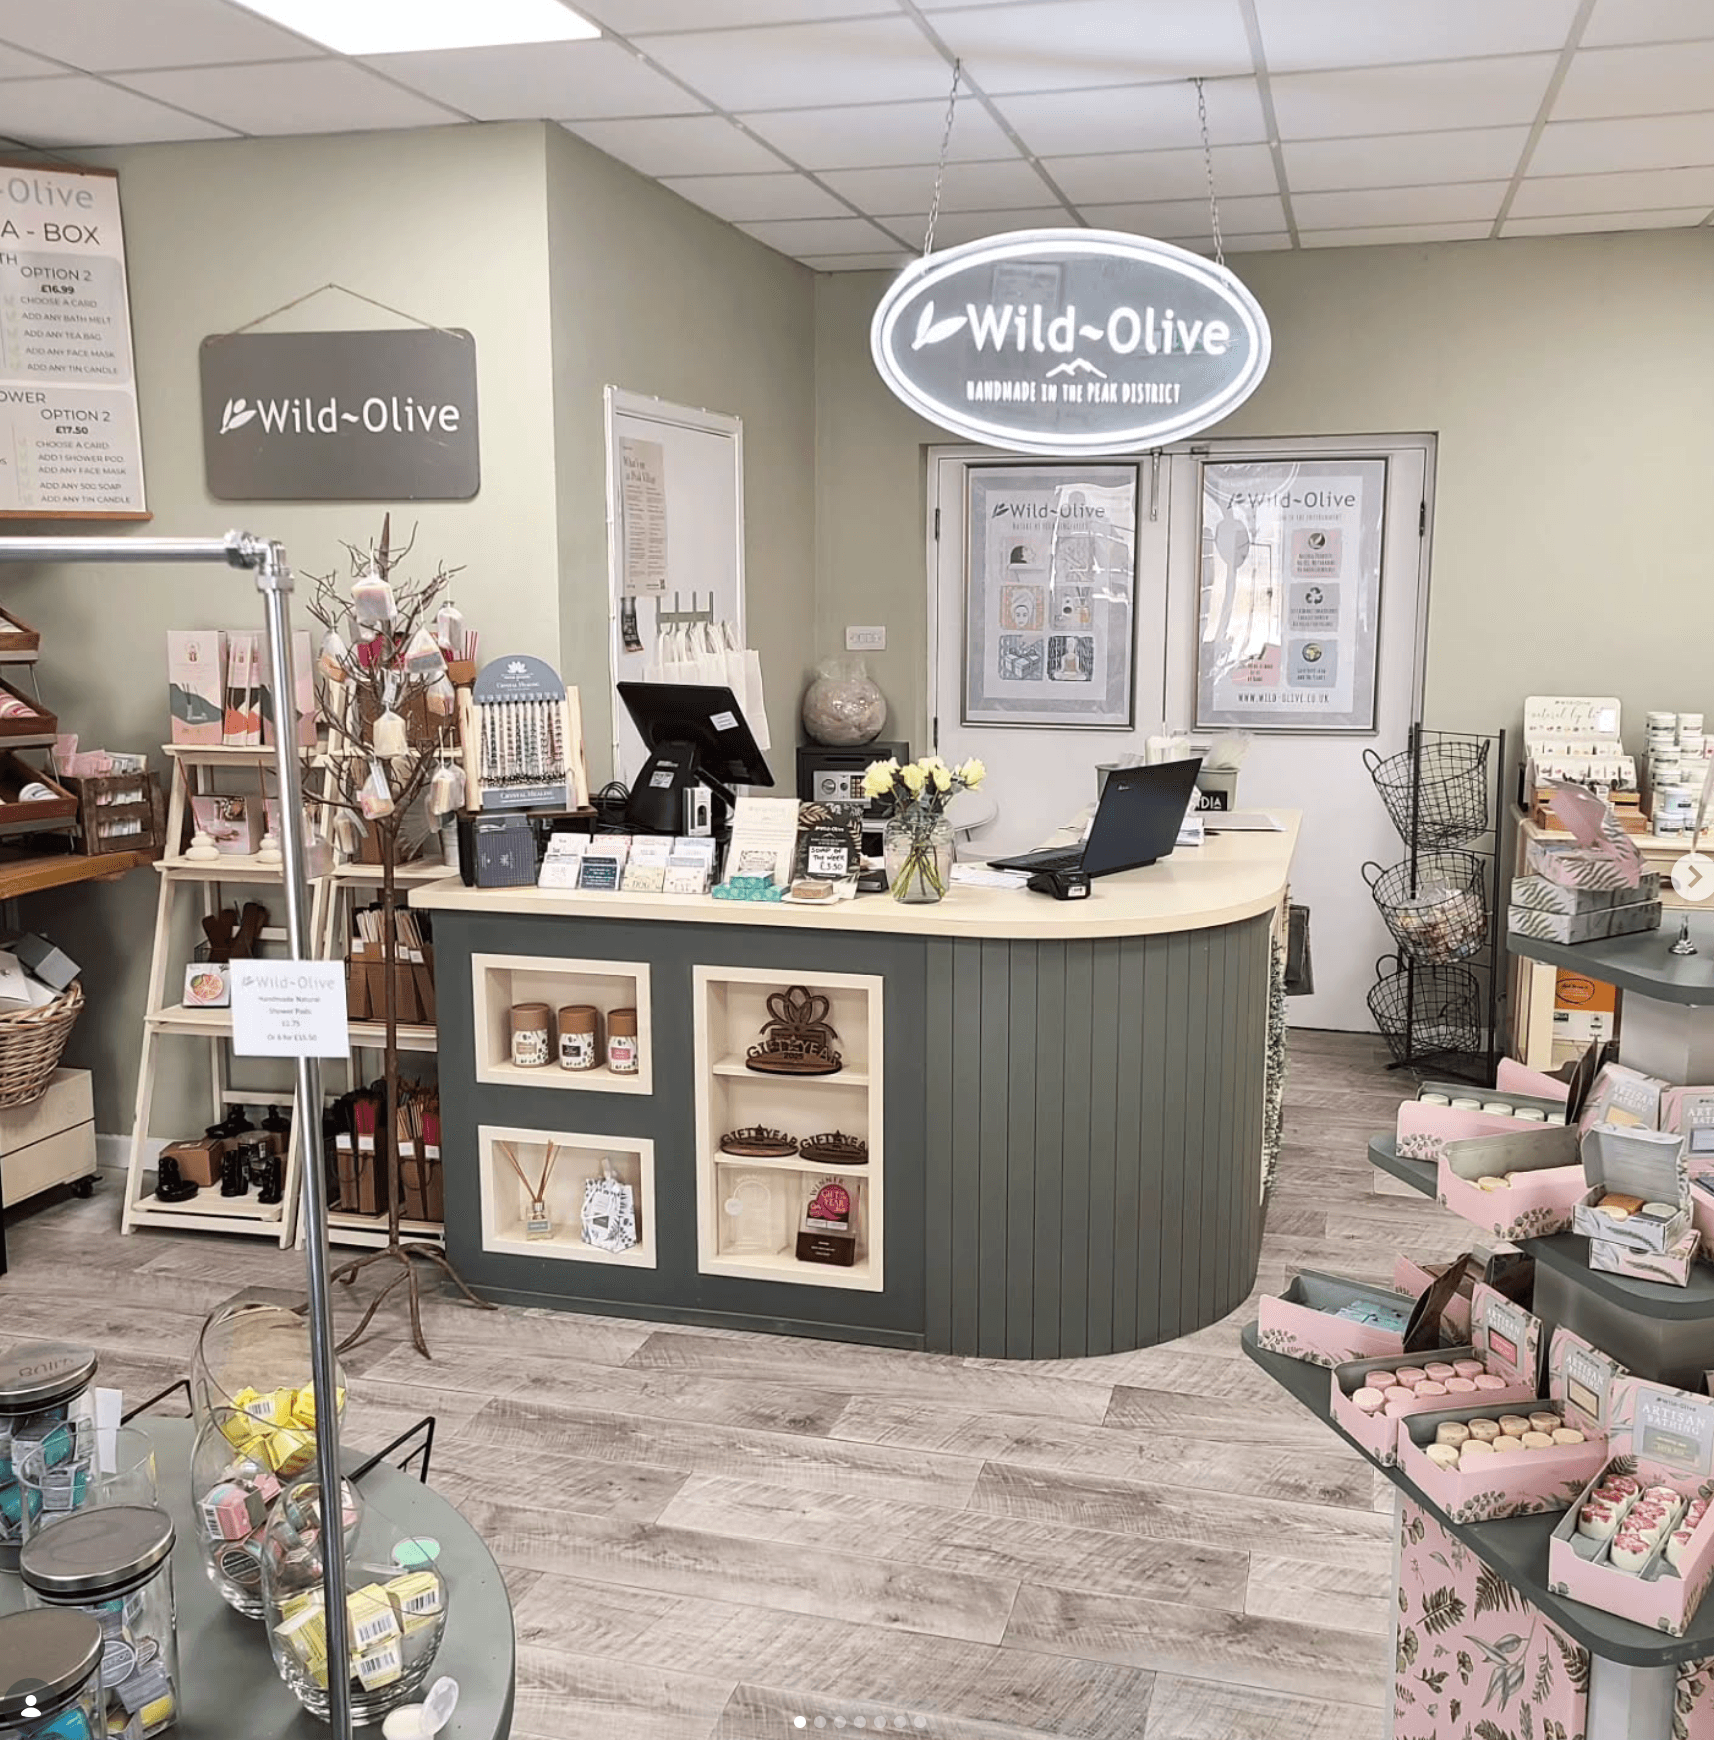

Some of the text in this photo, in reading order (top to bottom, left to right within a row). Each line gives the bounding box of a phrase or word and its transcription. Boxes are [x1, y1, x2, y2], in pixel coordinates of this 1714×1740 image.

[1, 219, 20, 239] A
[44, 222, 101, 246] BOX
[20, 266, 92, 282] OPTION 2
[41, 284, 75, 295] £16.99
[20, 296, 60, 306] CHOOSE
[70, 299, 98, 309] CARD
[22, 312, 42, 321] ADD
[44, 313, 62, 322] ANY
[24, 329, 42, 338] ADD
[45, 331, 62, 339] ANY
[26, 347, 45, 356] ADD
[46, 348, 64, 356] ANY
[28, 363, 46, 371] ADD
[48, 363, 66, 372] ANY
[0, 390, 46, 404] OWER
[966, 380, 1181, 405] HANDMADE IN THE PEAK DISTRICT
[40, 408, 111, 423] OPTION 2
[56, 425, 89, 435] £17.50
[36, 440, 73, 449] CHOOSE
[84, 441, 110, 450] CARD
[38, 454, 58, 462] ADD
[64, 455, 104, 463] SHOWER
[38, 466, 58, 474] ADD
[60, 466, 77, 474] ANY
[40, 482, 60, 490] ADD
[60, 482, 79, 490] ANY
[41, 495, 61, 503] ADD
[63, 495, 80, 503] ANY
[746, 1040, 842, 1065] GIFT YEAR
[721, 1127, 798, 1148] GIFT YEAR
[800, 1133, 834, 1150] GIFT
[1642, 1402, 1706, 1429] ARTISAN
[1647, 1413, 1699, 1436] BATHING
